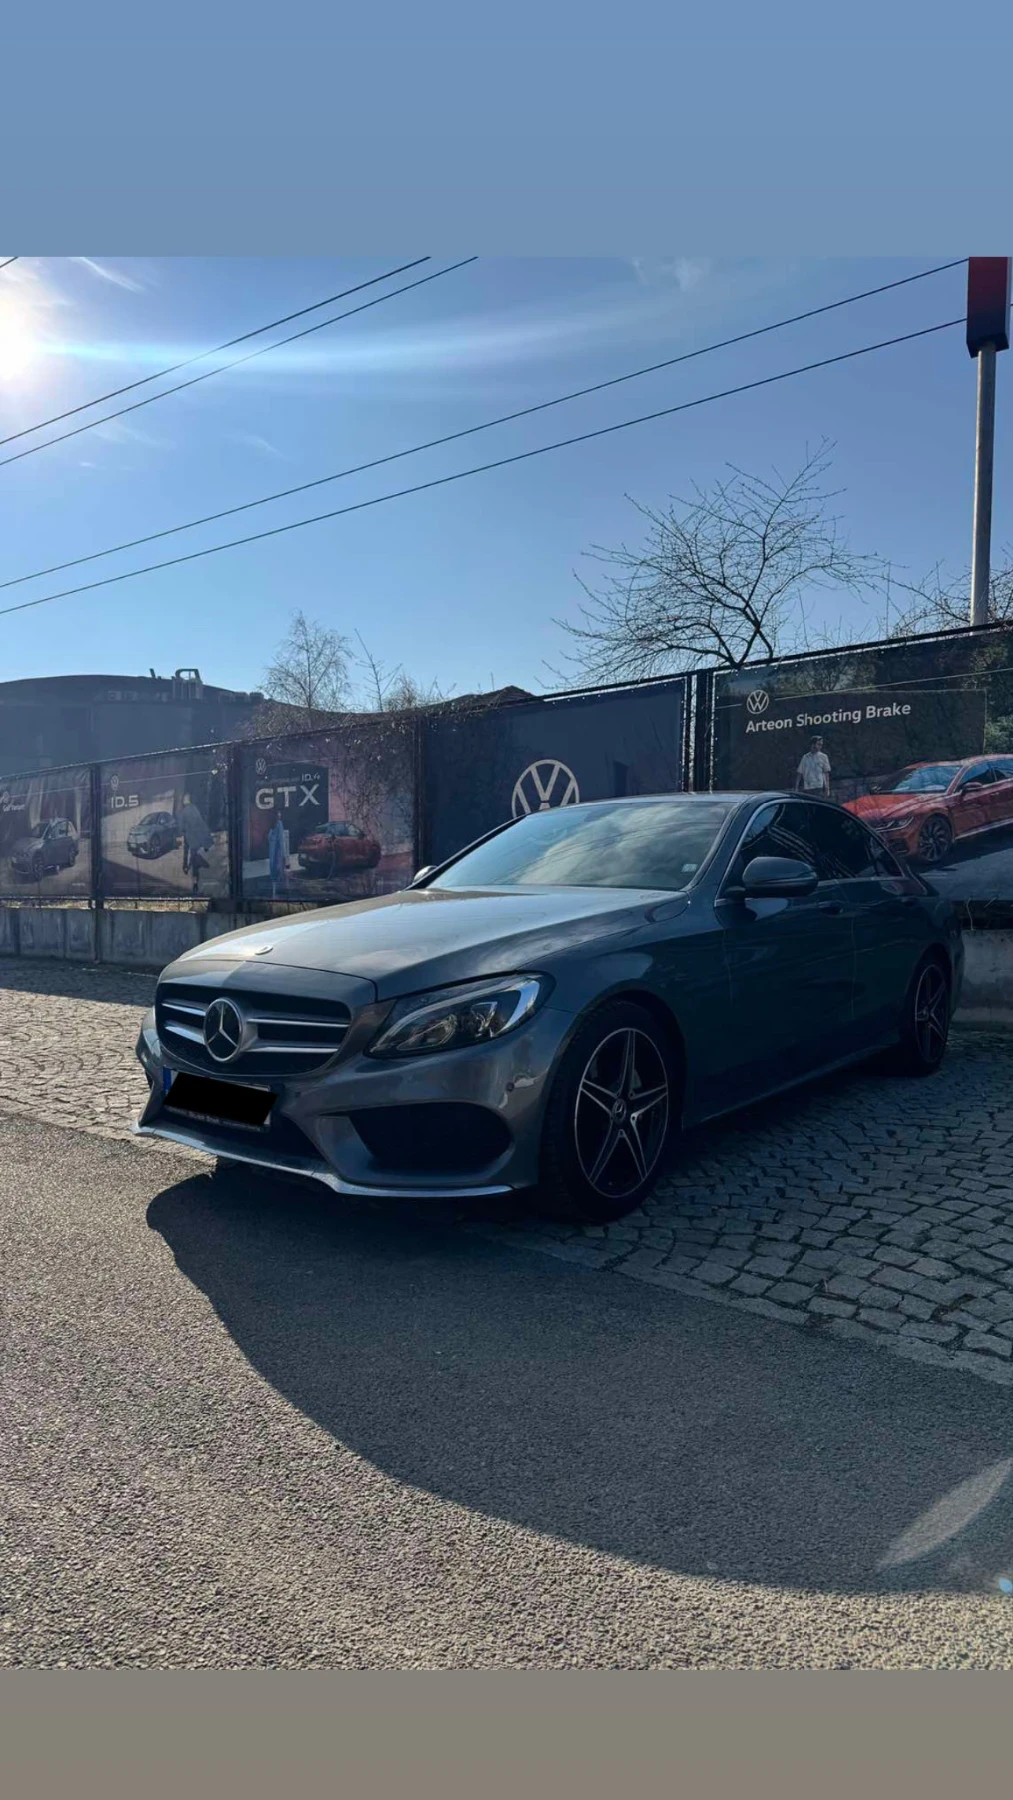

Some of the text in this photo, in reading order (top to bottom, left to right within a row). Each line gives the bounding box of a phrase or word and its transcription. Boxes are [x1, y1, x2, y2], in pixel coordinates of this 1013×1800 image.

[745, 702, 912, 734] Arteon Shooting Brake
[110, 794, 139, 809] ID.5
[255, 783, 321, 810] GTX
